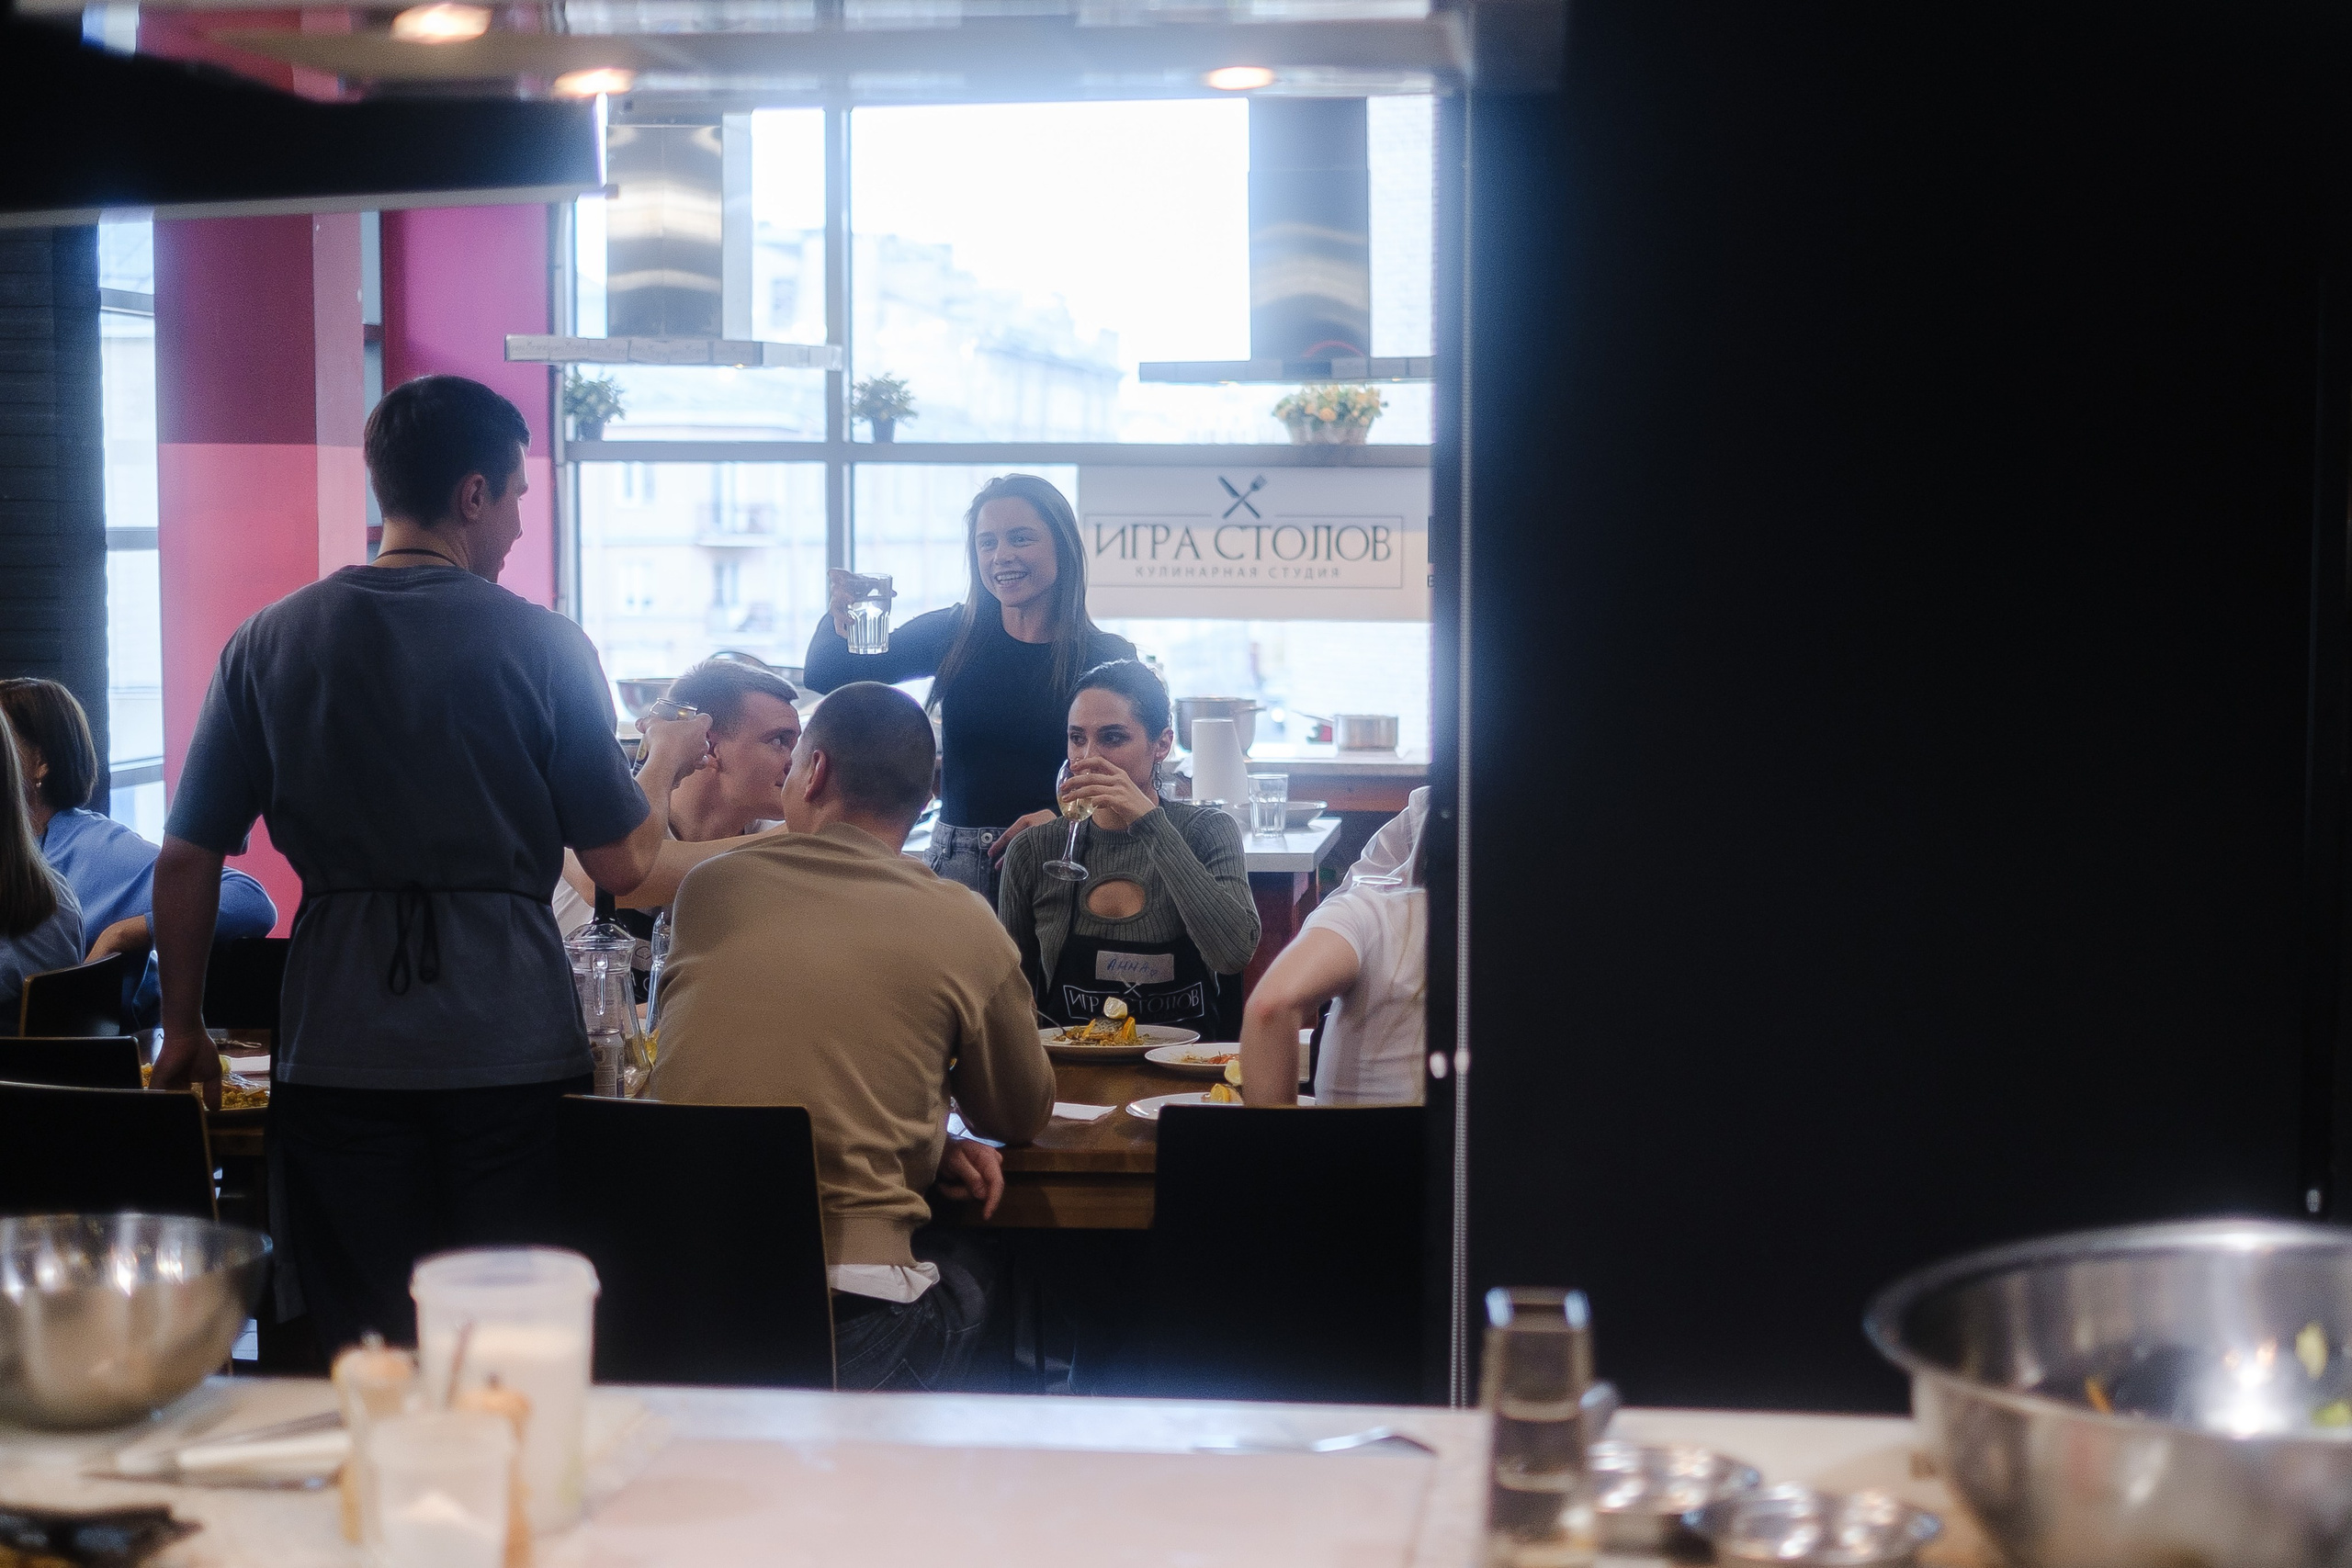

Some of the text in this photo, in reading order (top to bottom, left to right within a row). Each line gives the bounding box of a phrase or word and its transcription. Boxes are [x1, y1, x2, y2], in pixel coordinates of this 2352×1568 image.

[1096, 524, 1392, 561] ИГРА СТОЛОВ
[1135, 565, 1341, 581] КУЛИНАРНАЯ СТУДИЯ
[1069, 989, 1102, 1012] ИГР
